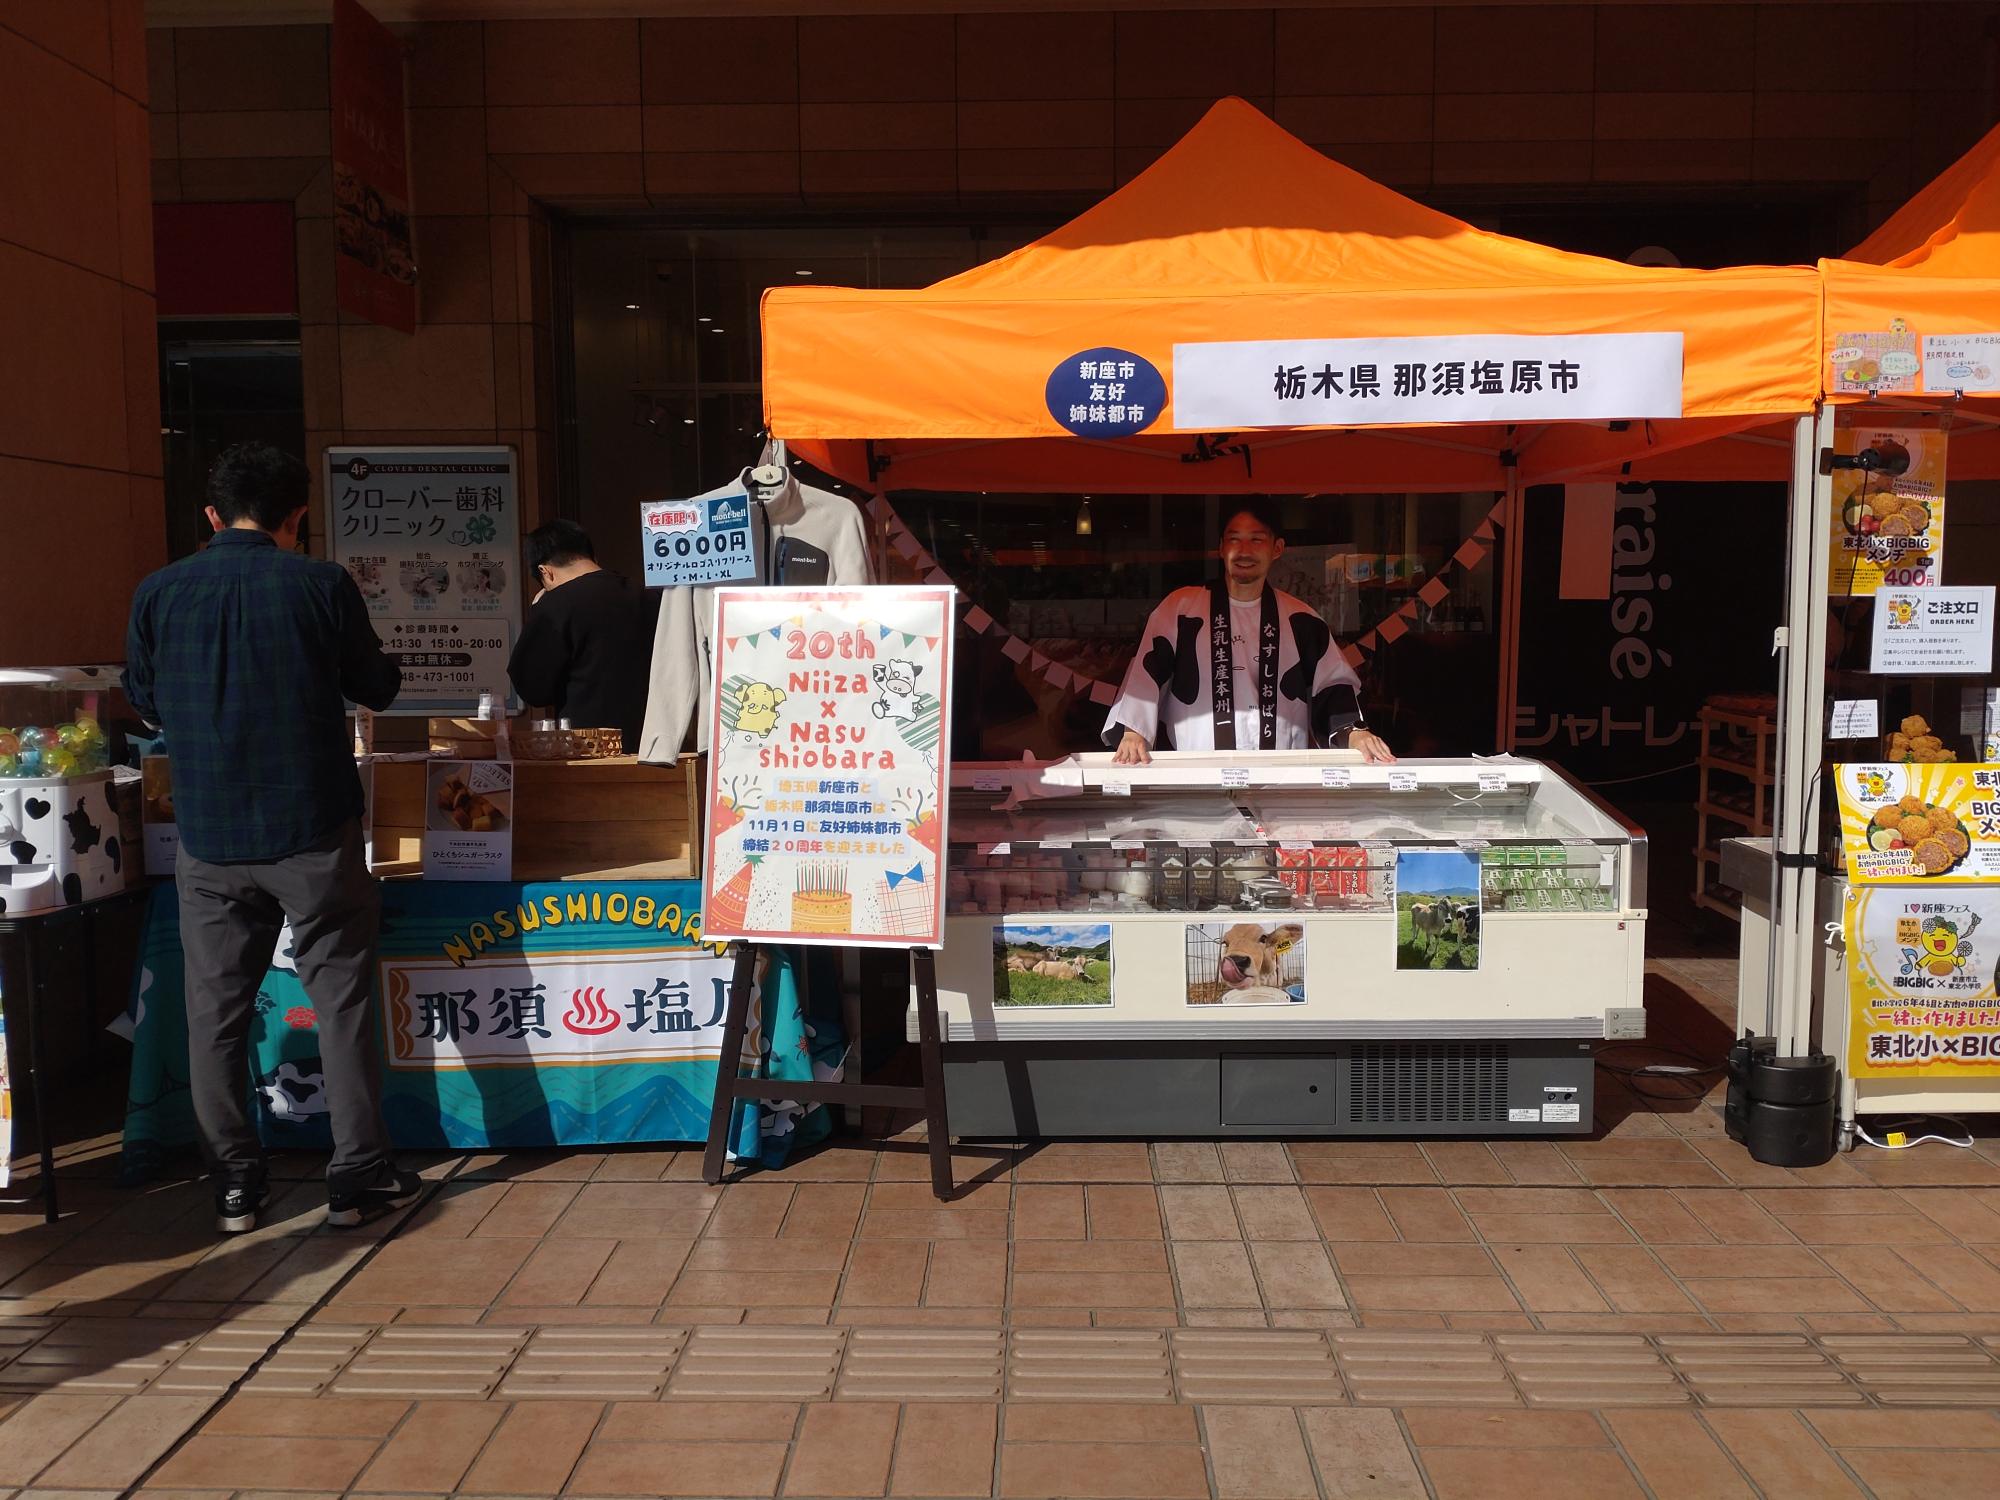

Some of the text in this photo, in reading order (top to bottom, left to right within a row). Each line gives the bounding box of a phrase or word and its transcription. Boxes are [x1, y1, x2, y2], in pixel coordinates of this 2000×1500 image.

[1079, 360, 1136, 380] 新座市
[1273, 359, 1582, 401] 栃木県 那須塩原市
[1089, 382, 1126, 402] 友好
[1069, 403, 1145, 424] 姉妹都市
[350, 463, 368, 476] 4F
[418, 465, 457, 473] DENTAL
[460, 464, 497, 473] CLINIC
[342, 486, 505, 512] クローバー歯科
[343, 515, 446, 537] クリニック
[647, 511, 697, 527] 在庫限り
[654, 531, 746, 557] 6000円
[1843, 537, 1930, 549] 東北小×BIGBIG
[647, 555, 752, 571] オリジナルロゴ入りフリース
[1866, 549, 1905, 561] メンチ
[1927, 601, 1979, 614] ご注文口
[430, 639, 502, 649] 15:00-20:00
[787, 629, 877, 660] 20th
[401, 653, 452, 665] 年中無休
[1212, 613, 1233, 728] 生乳生産本州一
[1261, 622, 1278, 739] なすしおばら
[788, 671, 869, 695] Niiza
[790, 721, 866, 744] Nasu
[759, 744, 896, 770] shiobara
[778, 780, 872, 795] 埼玉県新座市と
[764, 799, 886, 815] 栃木県那須塩原市は
[432, 851, 503, 859] ひとくちシュガーラスク
[1896, 976, 1935, 989] BIGBIG
[415, 983, 552, 1043] 那須
